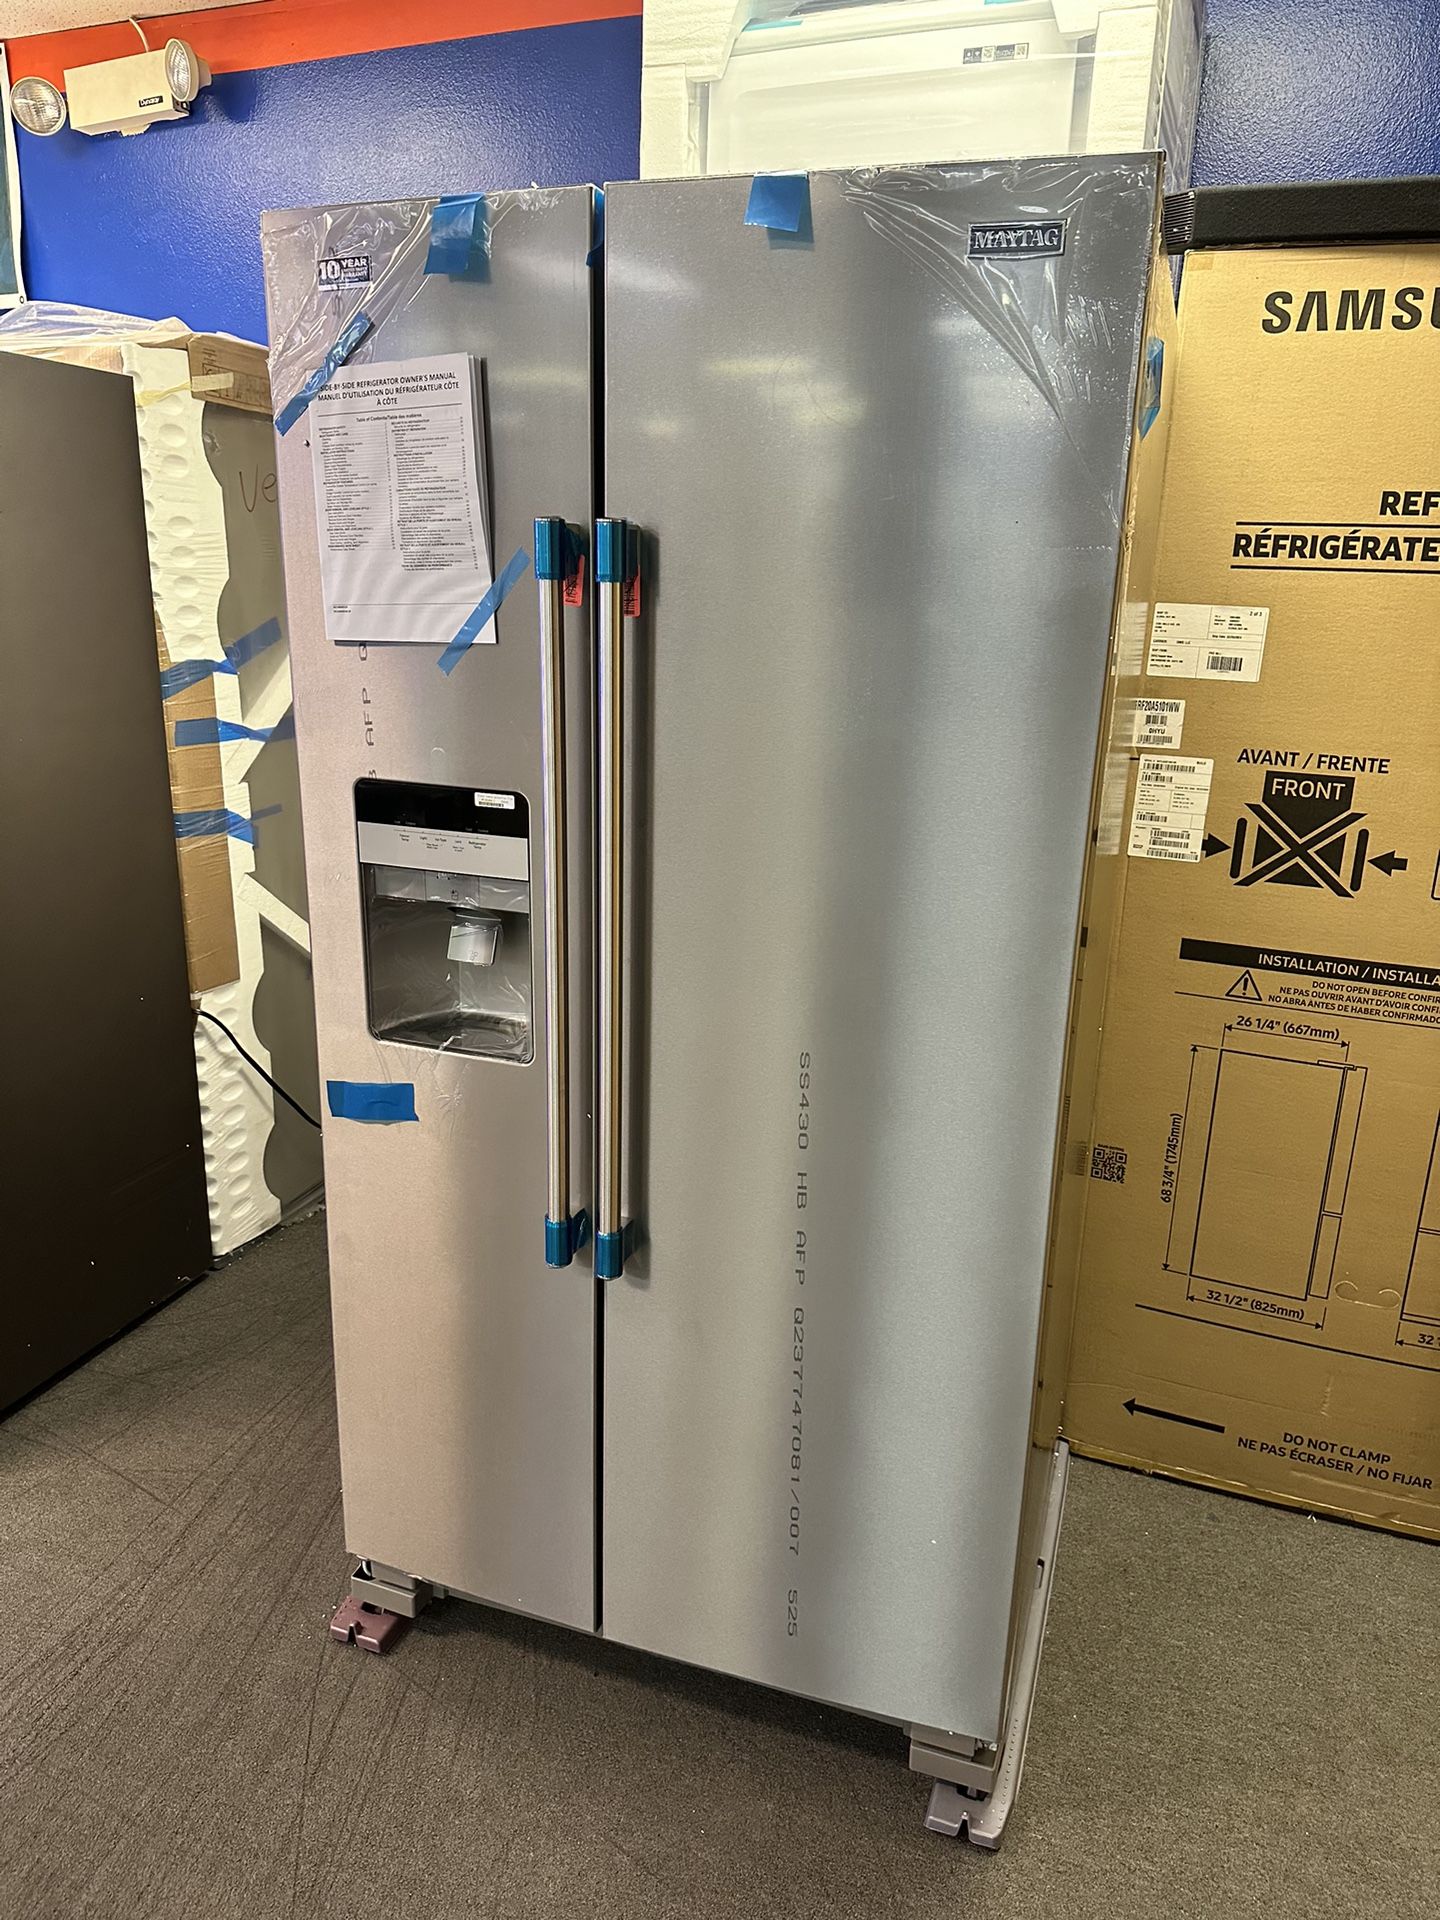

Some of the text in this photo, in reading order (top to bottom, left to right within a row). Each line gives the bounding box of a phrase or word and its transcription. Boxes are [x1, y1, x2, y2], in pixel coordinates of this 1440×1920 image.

[973, 228, 1059, 249] MAYTAG
[319, 257, 367, 280] 10 YEAR
[1262, 287, 1440, 334] SAMS
[318, 381, 460, 402] MANUEL D'UTILISATION DU RÉFRIGÉRATEUR CÔTE
[356, 377, 399, 388] REFRIGERATOR
[400, 375, 428, 384] OWNER'S
[429, 372, 456, 382] MANUAL
[382, 397, 398, 406] CÔTE
[1379, 490, 1440, 516] REF
[1232, 528, 1440, 562] RÉFRIGÉRATE
[1237, 748, 1391, 774] AVANT / FRENTE
[1271, 777, 1346, 801] FRONT
[1258, 953, 1359, 976] INSTALLATION
[1361, 966, 1370, 978] /
[1280, 986, 1292, 994] NE
[1292, 988, 1310, 997] PAS
[1311, 991, 1345, 1003] OUVRIR
[1345, 996, 1374, 1006] AVANT
[1375, 999, 1411, 1010] D'AVOIR
[1312, 981, 1326, 989] DO
[1327, 983, 1346, 992] NOT
[1346, 984, 1371, 995] OPEN
[1368, 989, 1406, 1000] BEFORE
[1268, 994, 1282, 1003] NO
[1282, 996, 1307, 1007] ABRA
[1307, 1000, 1336, 1010] ANTES
[1337, 1004, 1350, 1012] DE
[1350, 1006, 1381, 1017] HABER
[1236, 1015, 1340, 1041] 26 1/4" (667mm)
[798, 1051, 811, 1150] SS430
[1160, 1113, 1184, 1204] 68 3/4" (1745mm)
[796, 1172, 808, 1210] HB
[795, 1230, 808, 1286] AFP
[1206, 1289, 1305, 1320] 32 1/2" (825mm)
[1418, 1333, 1434, 1345] 32
[1283, 1432, 1391, 1465] DO NOT CLAMP
[1237, 1437, 1433, 1489] NE PAS ÉCRASER / NO FIJAR
[787, 1589, 798, 1638] 525
